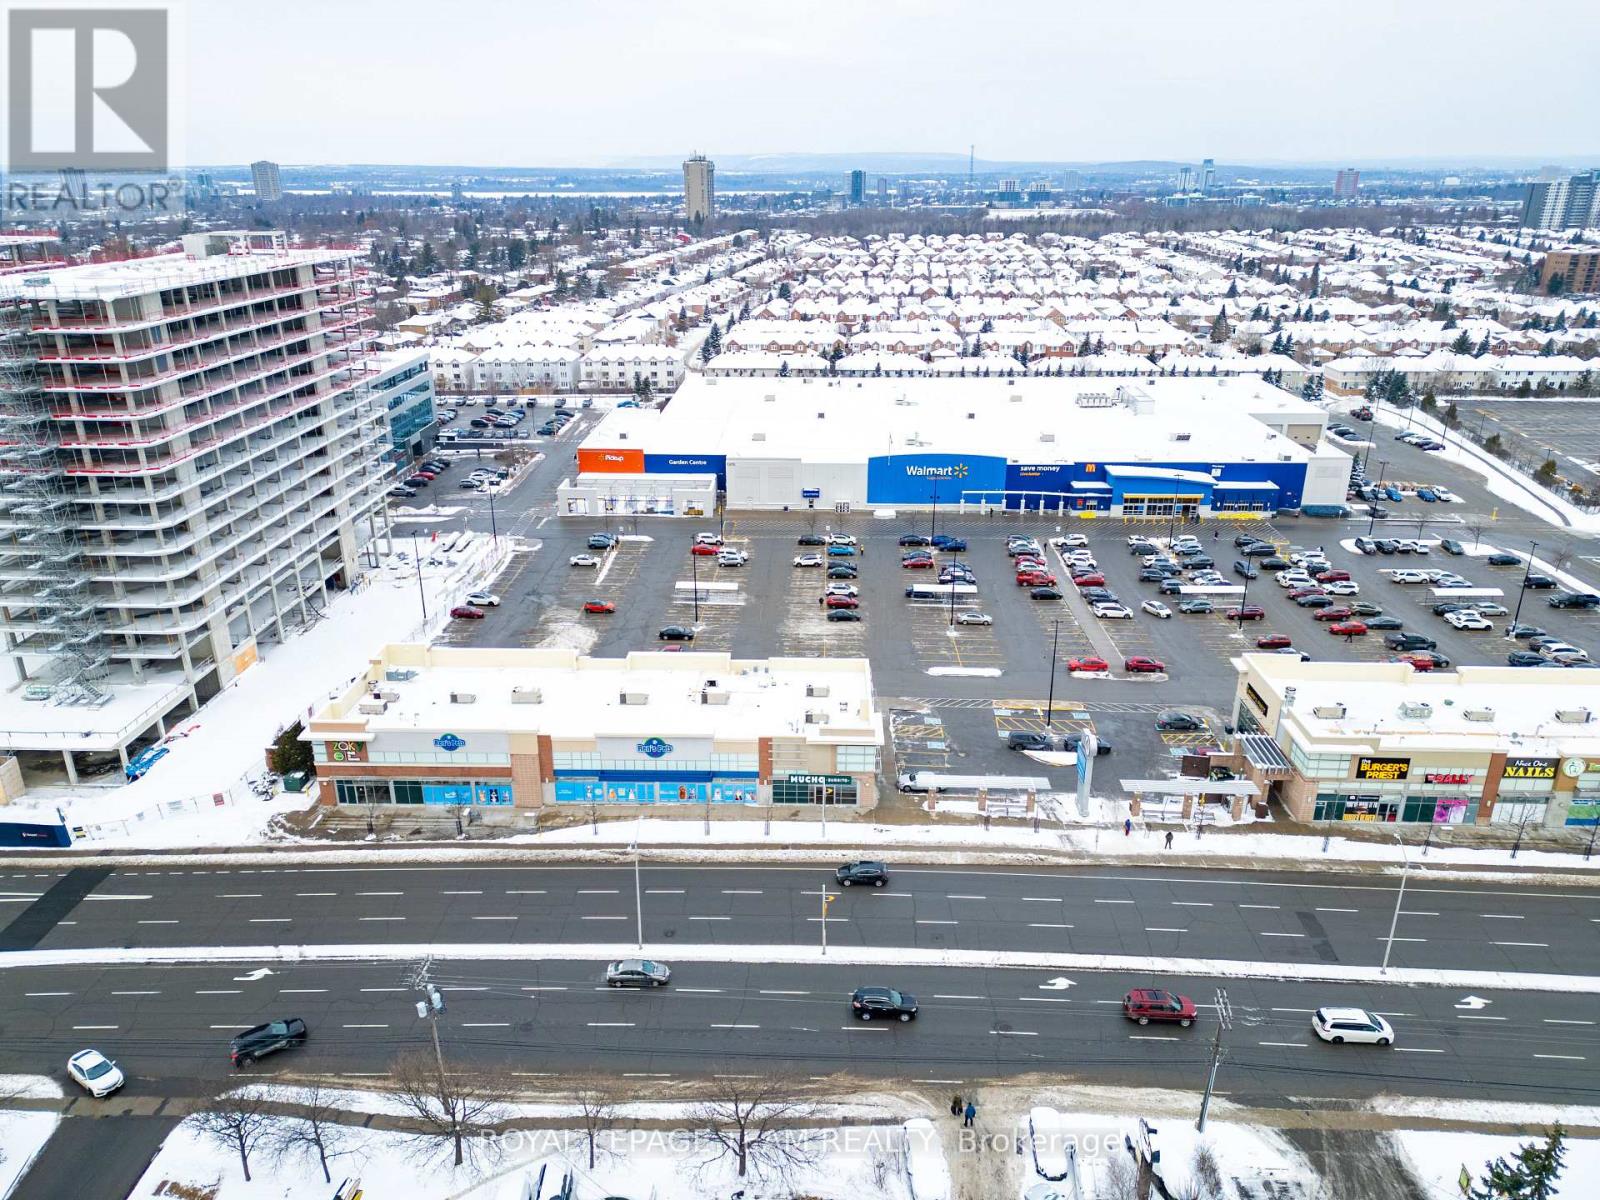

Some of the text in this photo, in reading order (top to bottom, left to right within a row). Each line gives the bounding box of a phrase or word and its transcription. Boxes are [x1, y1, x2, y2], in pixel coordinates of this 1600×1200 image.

[906, 466, 952, 476] Walmart
[1360, 763, 1409, 772] BURGER'S
[1503, 766, 1555, 777] NAILS
[790, 775, 826, 784] MUCHO
[1366, 771, 1400, 780] PRIEST
